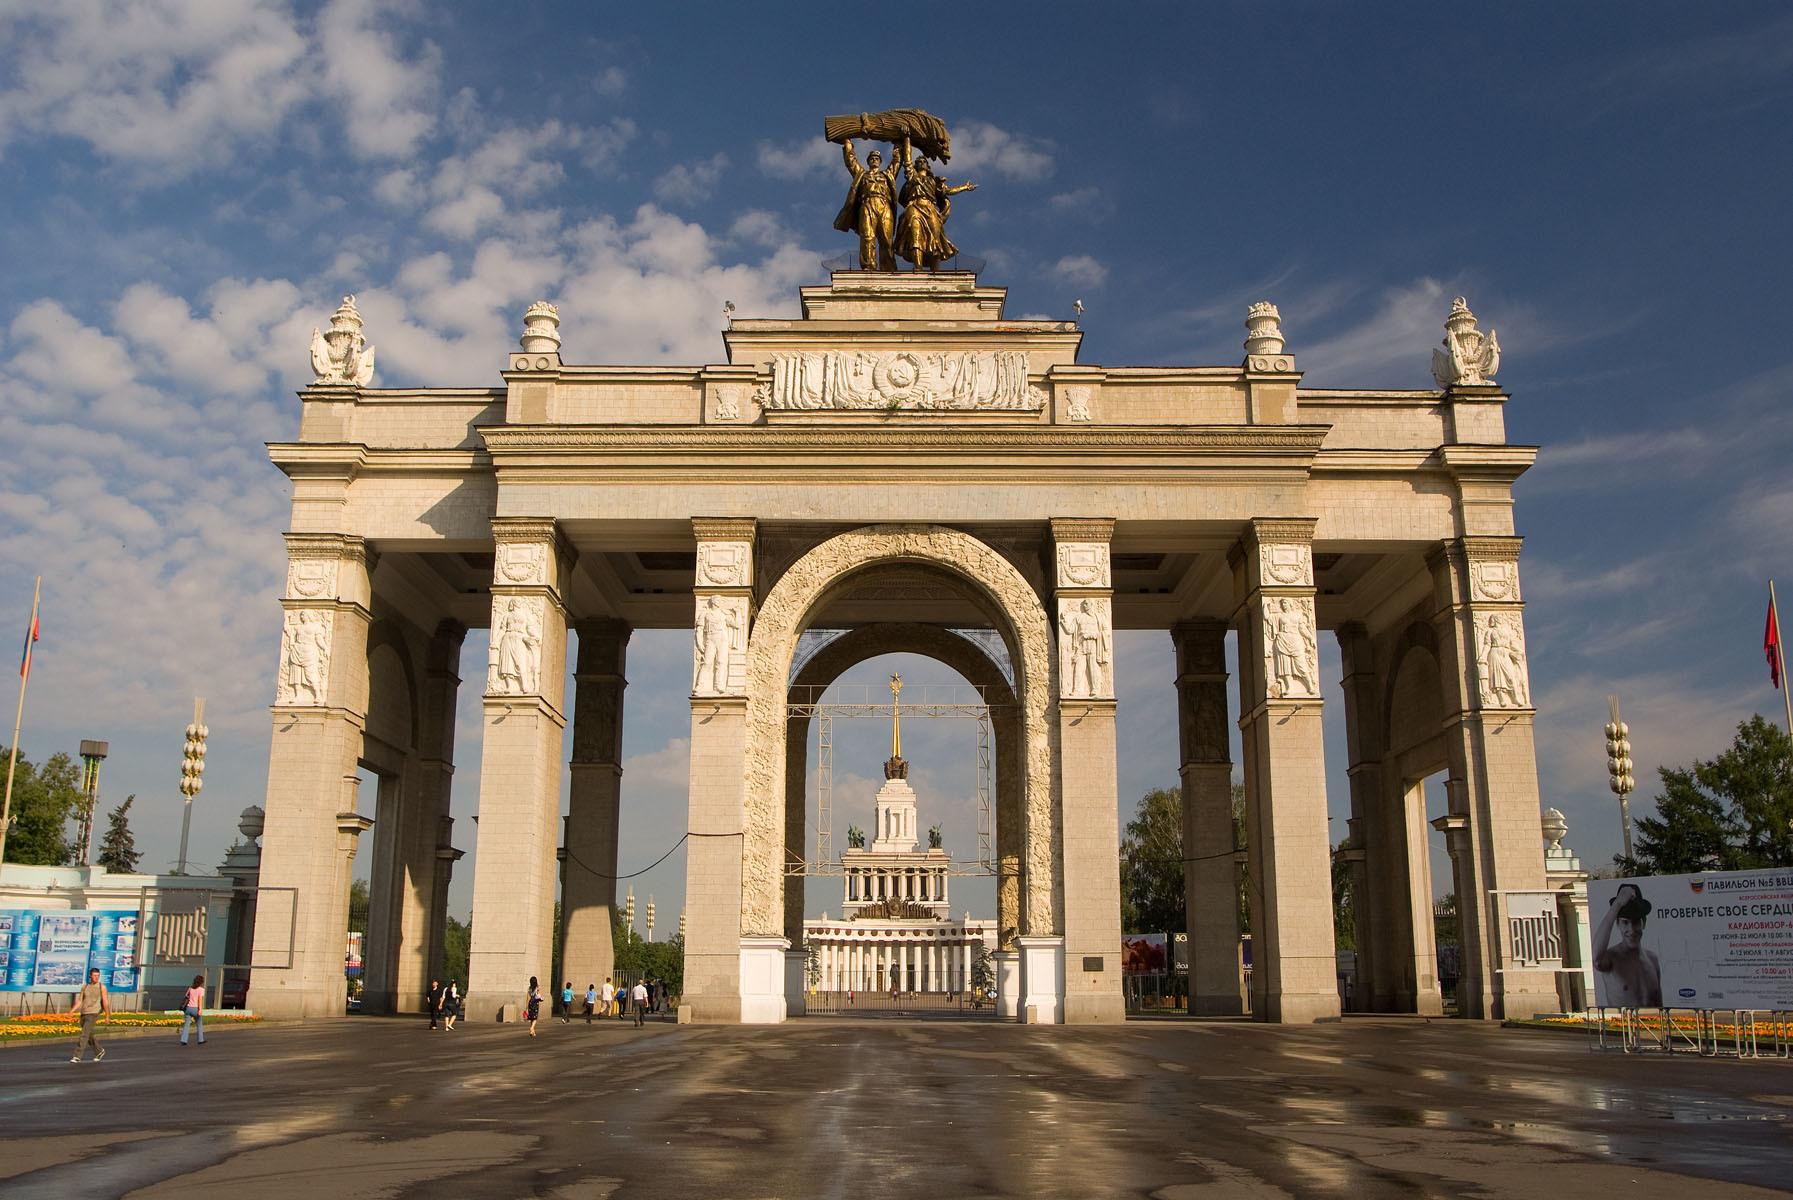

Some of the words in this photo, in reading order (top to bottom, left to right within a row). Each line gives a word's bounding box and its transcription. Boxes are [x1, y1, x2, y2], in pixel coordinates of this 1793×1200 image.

[1707, 879, 1756, 890] ПАВИЛЬОН
[1758, 878, 1774, 887] №5
[1657, 907, 1714, 919] ПРОВЕРЬТЕ
[1717, 905, 1748, 916] СВОЕ
[1751, 903, 1793, 916] СЕРДЦ
